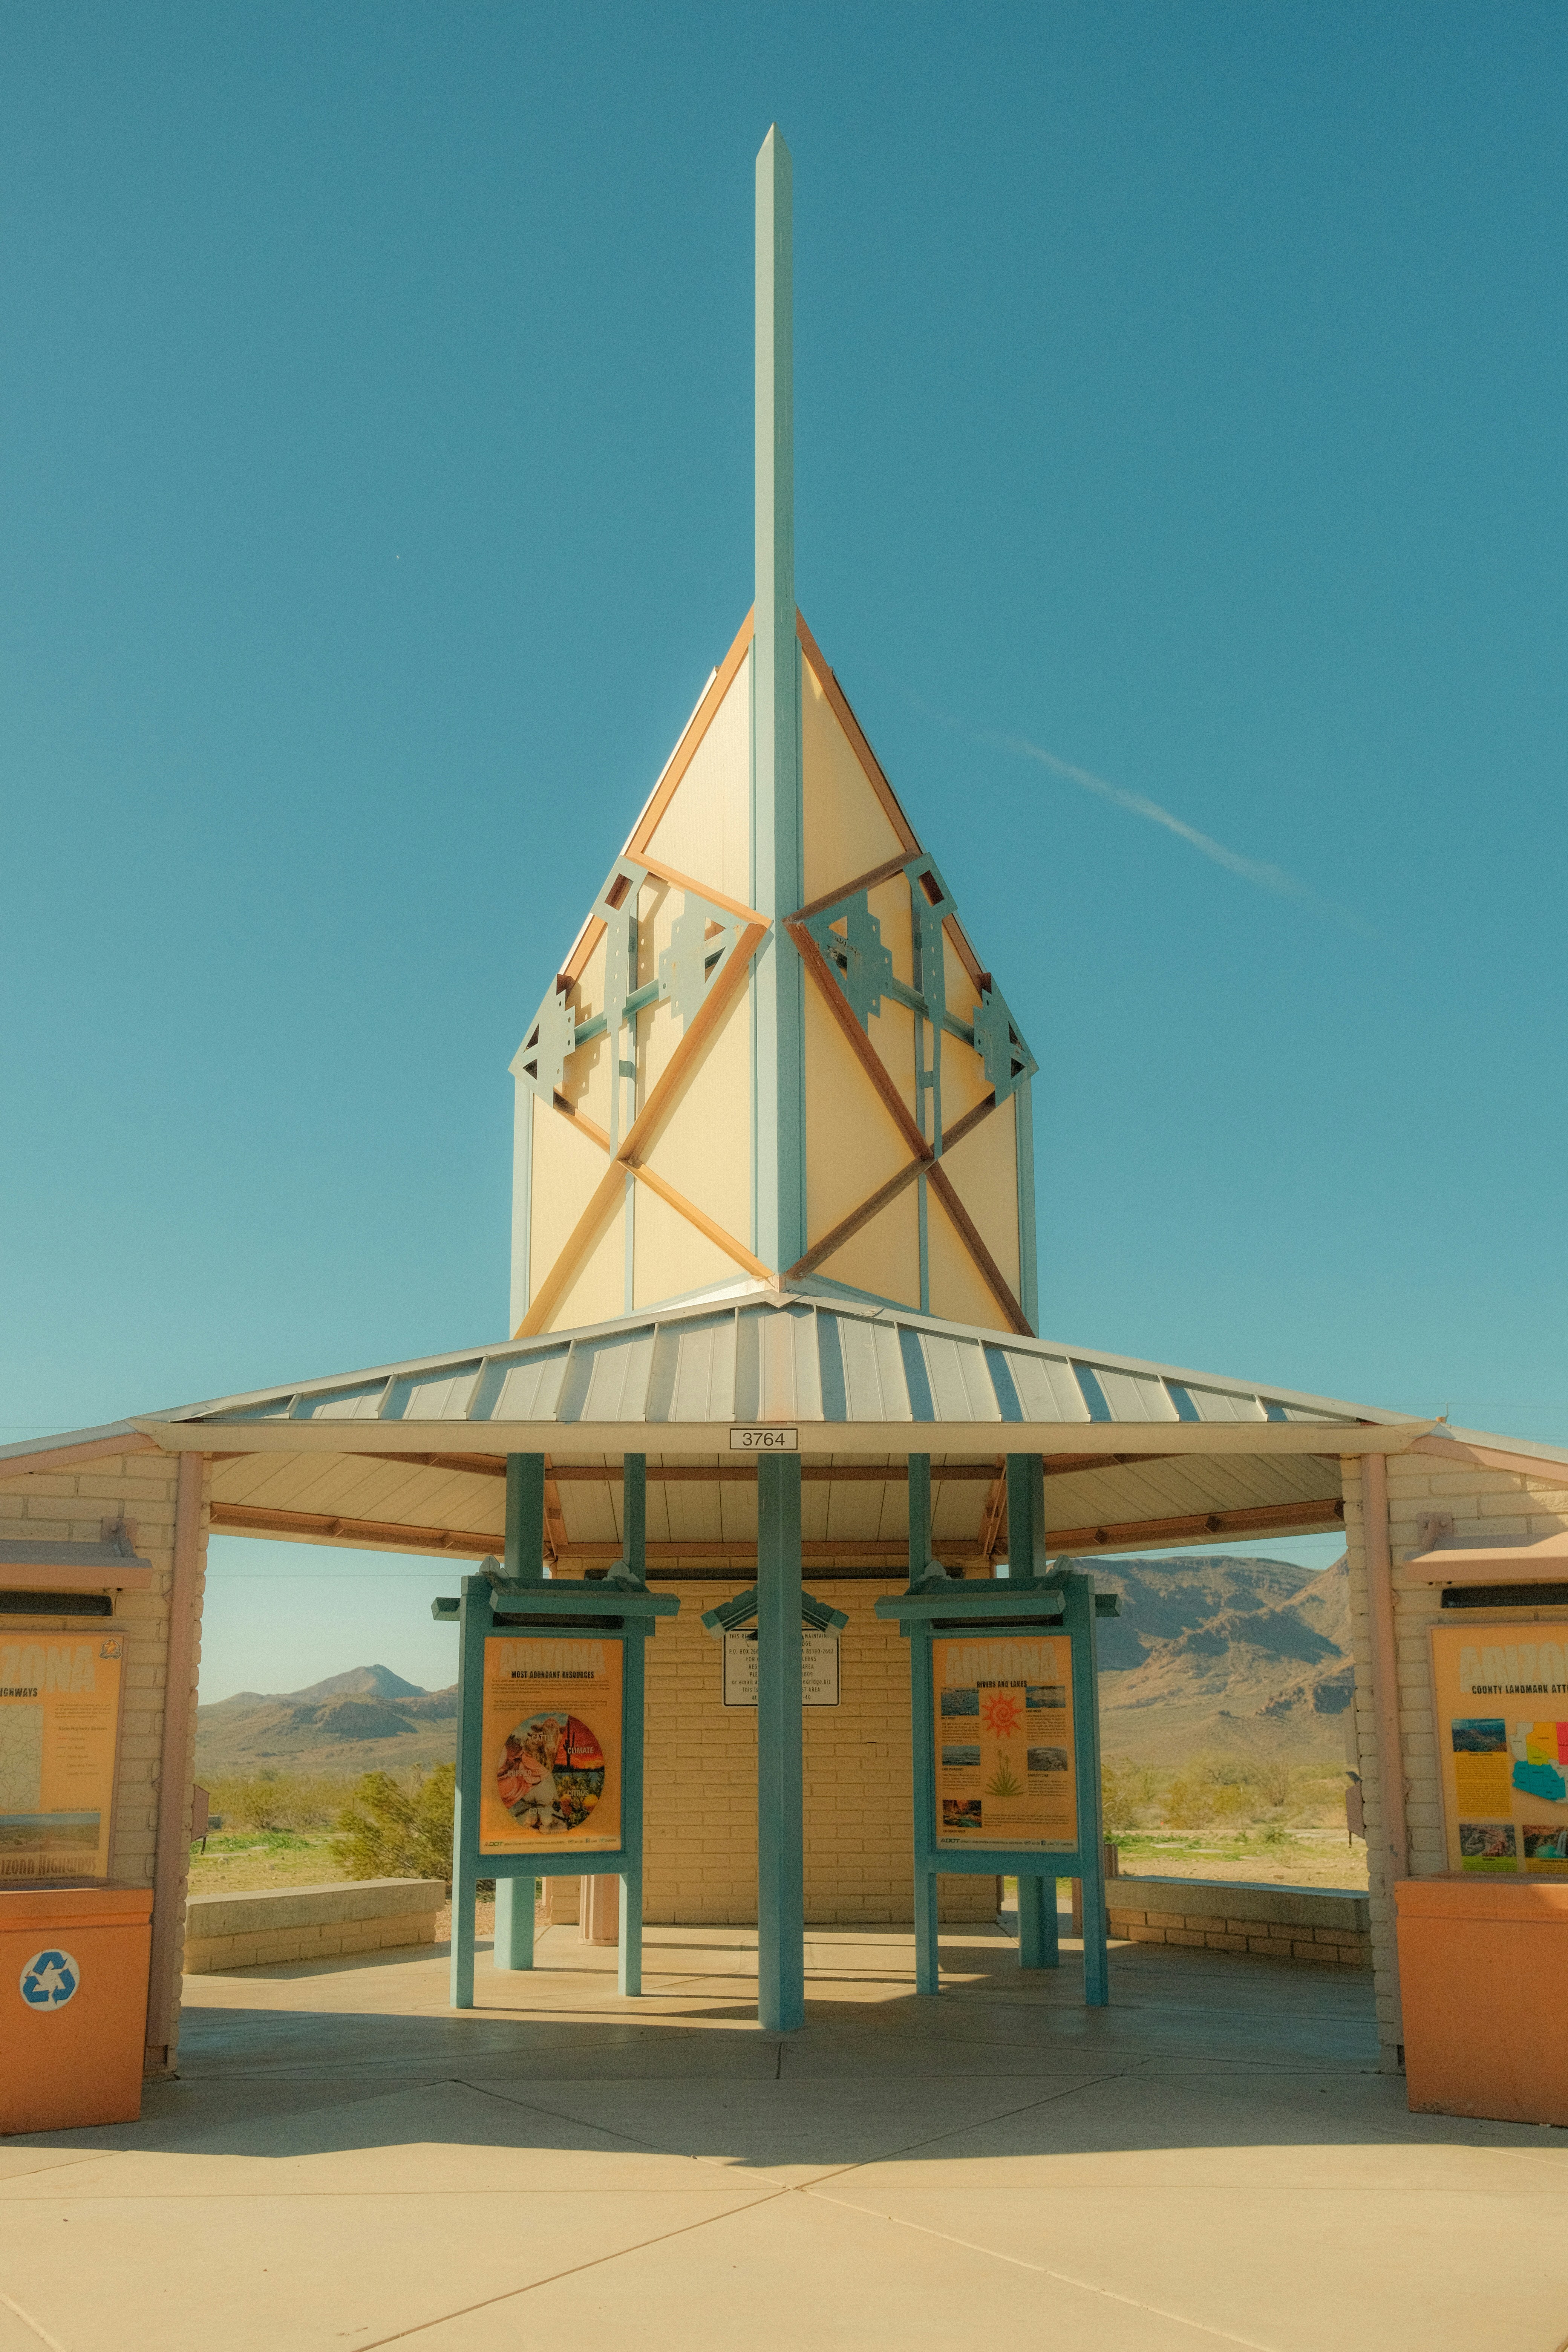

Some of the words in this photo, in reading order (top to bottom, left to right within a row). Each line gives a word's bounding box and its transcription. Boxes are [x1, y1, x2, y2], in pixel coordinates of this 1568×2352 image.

[743, 1433, 785, 1446] 3764
[499, 1642, 605, 1676] ARIZONA
[945, 1643, 1058, 1684] ARIZONA
[1460, 1642, 1568, 1693] ARIZO
[1472, 1685, 1502, 1694] COUNTY
[1505, 1684, 1548, 1694] LANDMARK
[1552, 1684, 1568, 1694] ATT
